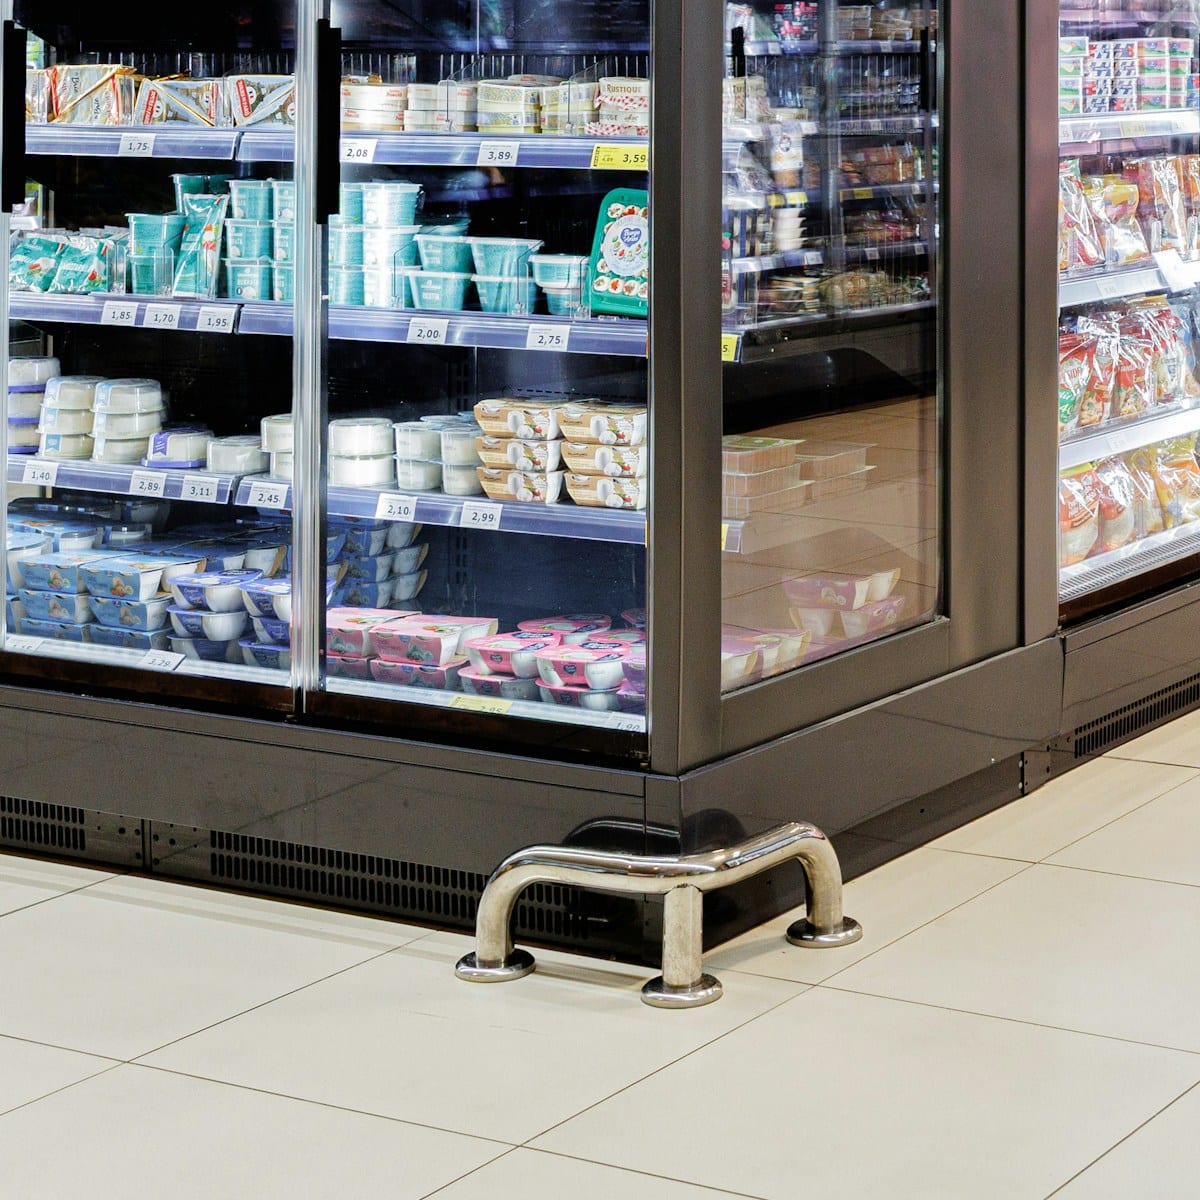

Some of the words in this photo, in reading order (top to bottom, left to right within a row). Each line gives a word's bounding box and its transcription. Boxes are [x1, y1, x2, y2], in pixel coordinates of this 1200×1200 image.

[127, 142, 148, 151] 1,75
[346, 148, 368, 157] 2,08
[487, 151, 511, 161] 3,89
[622, 153, 647, 164] 3,59
[111, 311, 131, 320] 1,85
[153, 313, 174, 323] 1,70
[207, 317, 227, 327] 1,95
[416, 329, 439, 339] 2,00
[537, 335, 561, 345] 2,75
[31, 471, 50, 480] 1,40
[138, 481, 159, 492] 2,89
[190, 486, 210, 497] 3,11
[258, 493, 279, 503] 2,45
[387, 504, 410, 516] 2,10
[471, 511, 495, 523] 2,99
